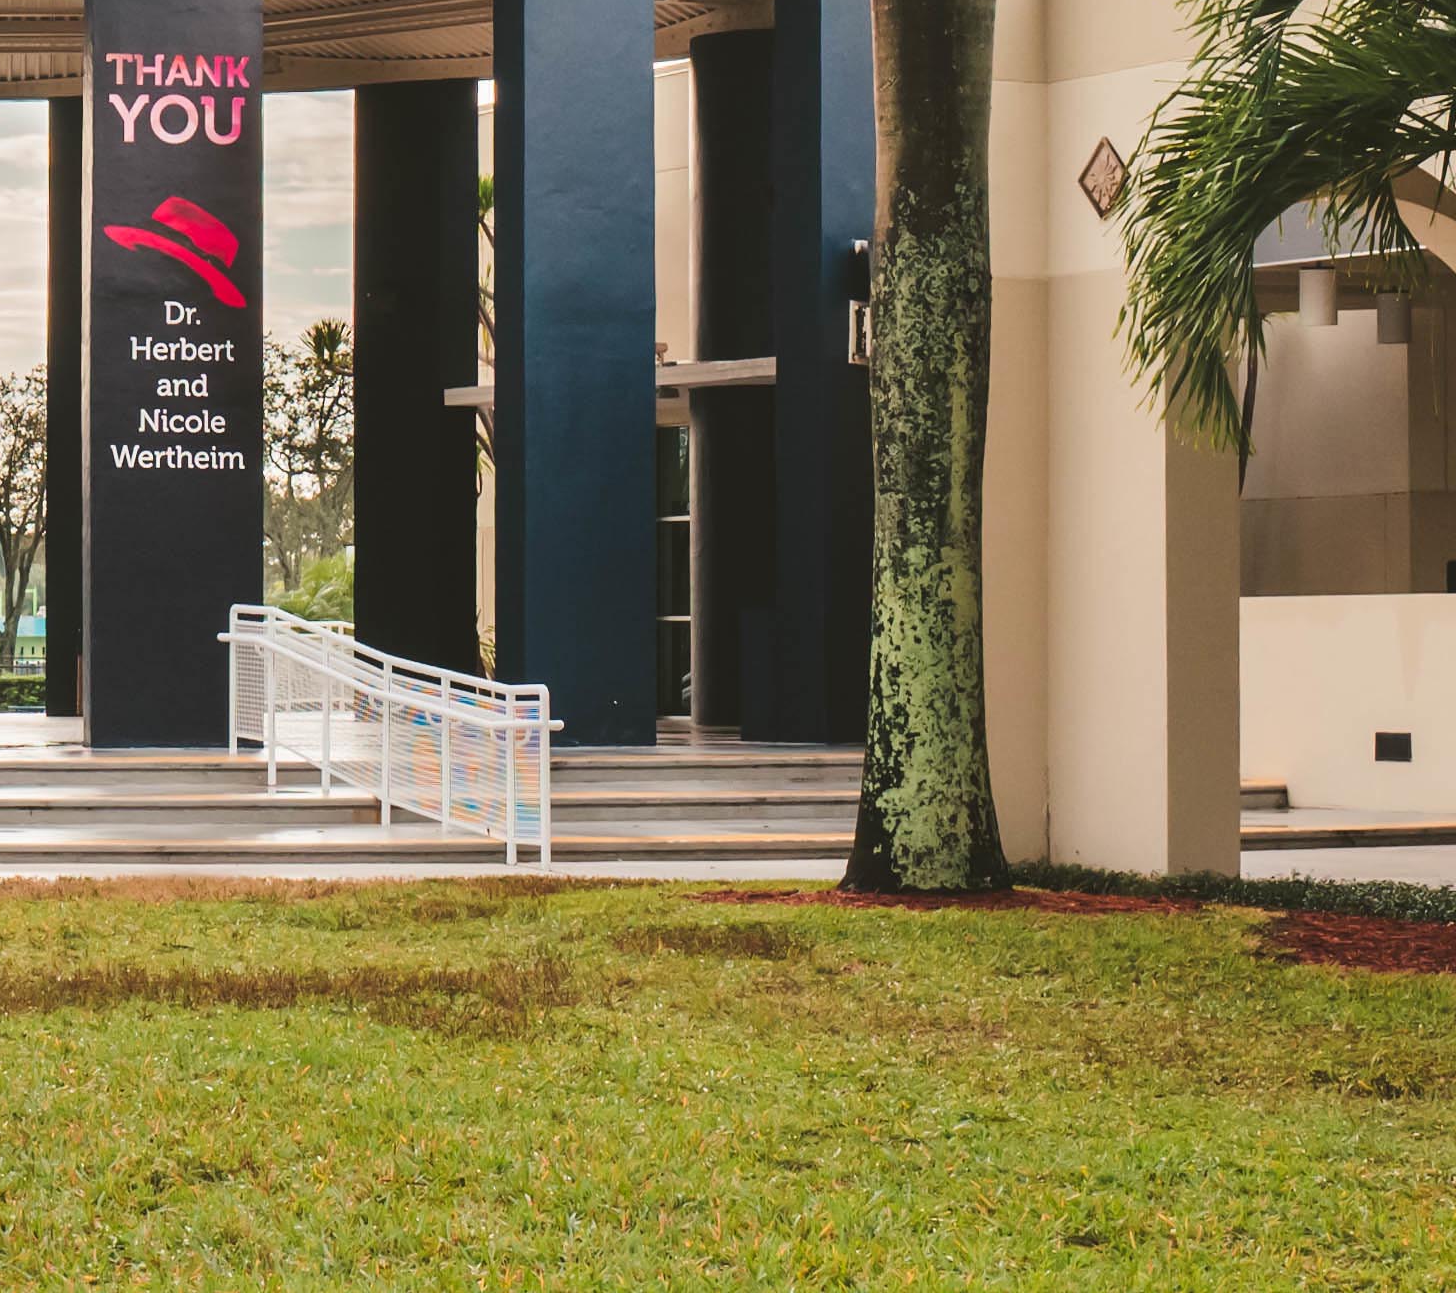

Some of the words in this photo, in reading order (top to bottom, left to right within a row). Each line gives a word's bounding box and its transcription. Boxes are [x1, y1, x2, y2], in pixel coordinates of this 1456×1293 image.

[105, 52, 251, 89] THANK
[108, 93, 246, 146] YOU
[163, 300, 202, 326] Dr.
[129, 336, 235, 362] Herbert
[156, 373, 209, 398] and
[138, 409, 227, 434] Nicole
[110, 444, 246, 470] Wertheim
